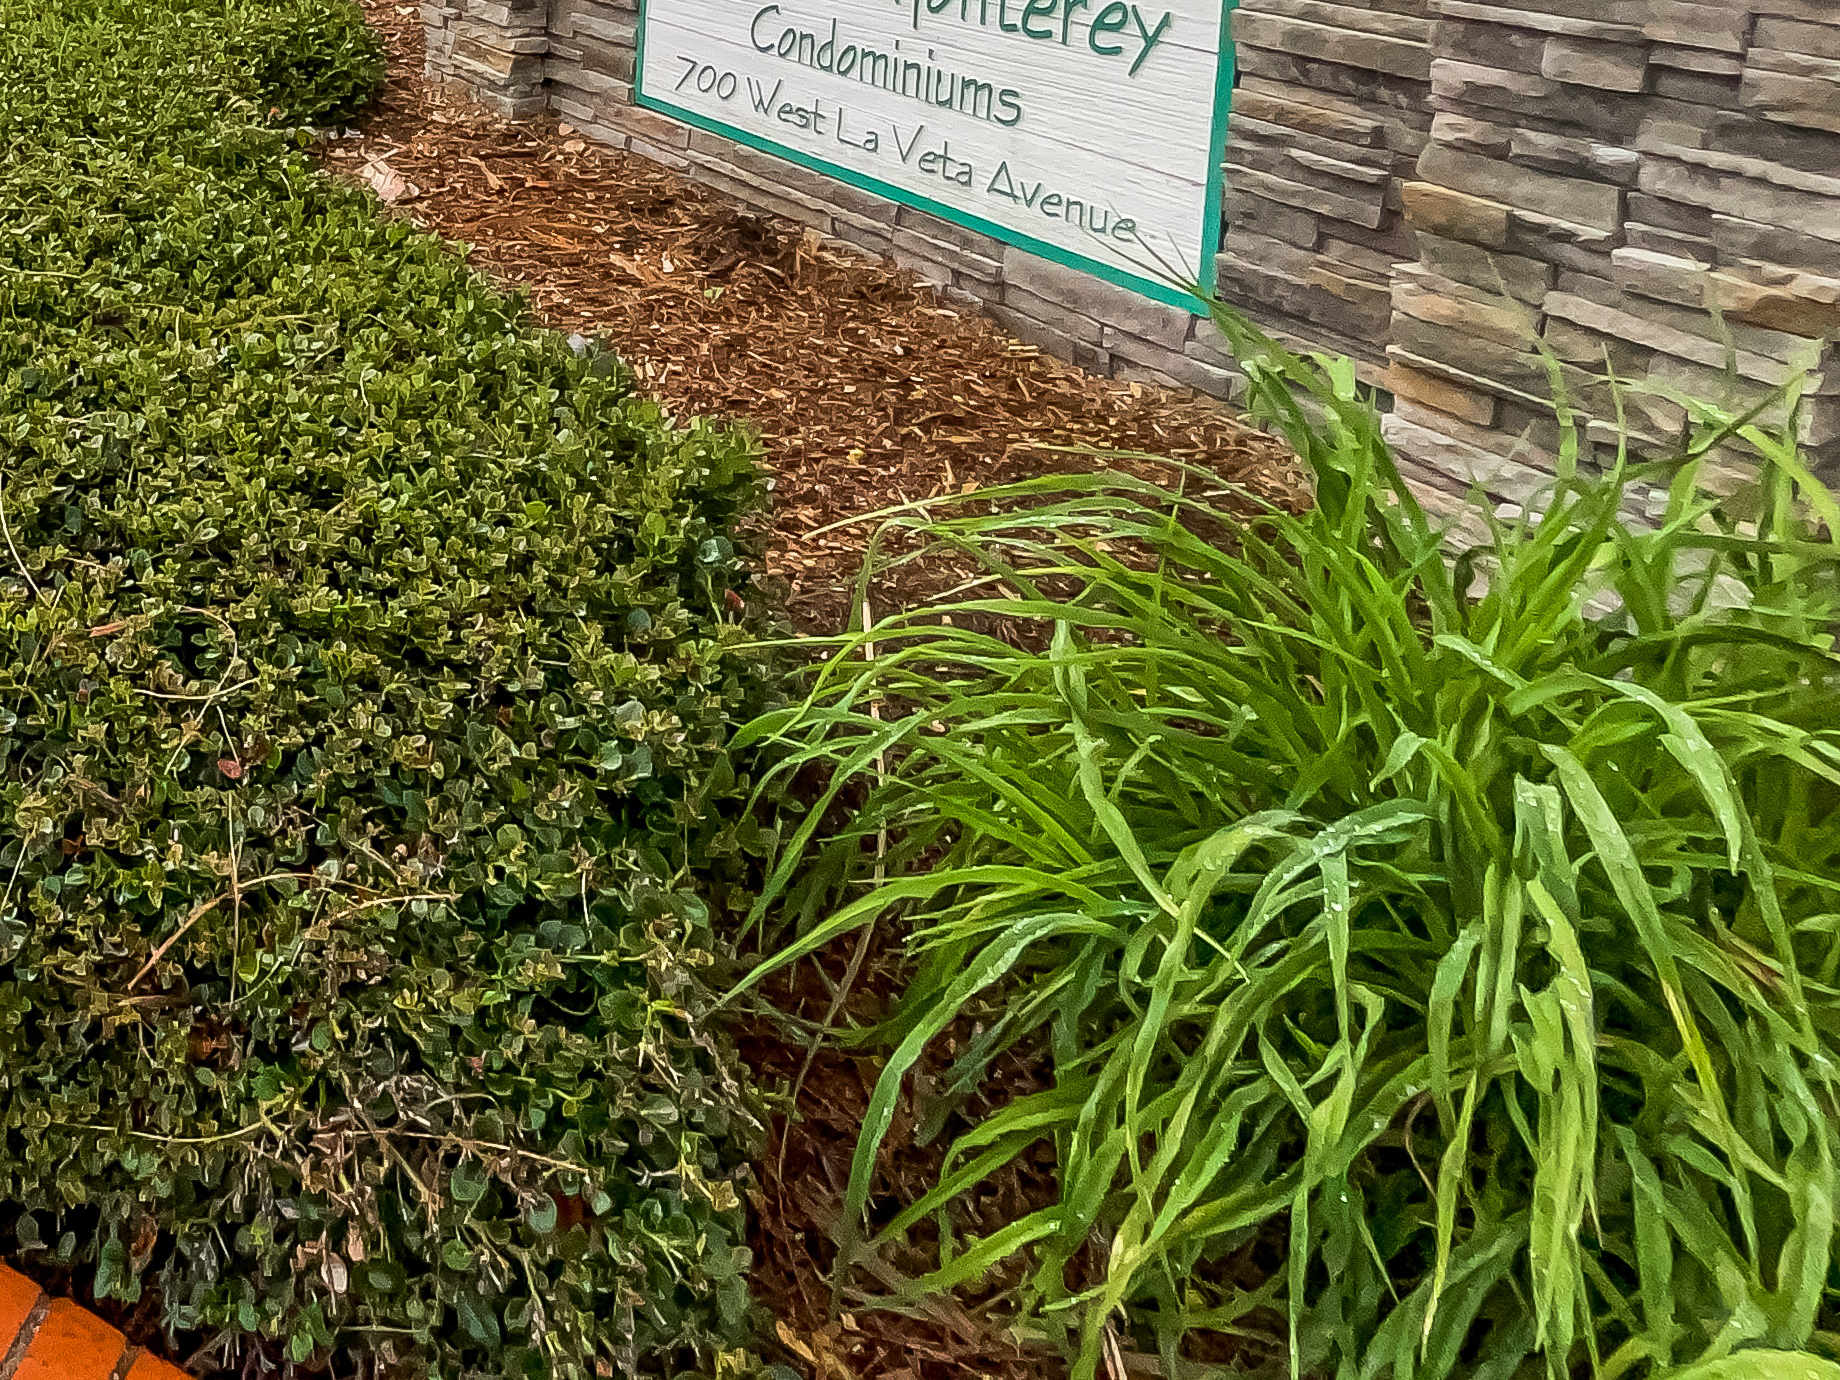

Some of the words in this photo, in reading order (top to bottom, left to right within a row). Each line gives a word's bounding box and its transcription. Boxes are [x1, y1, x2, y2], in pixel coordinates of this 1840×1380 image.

[751, 4, 1023, 127] Condominiums
[674, 55, 738, 100] 700
[746, 76, 827, 136] West
[836, 107, 880, 154] La
[892, 123, 973, 188] Veta
[987, 160, 1137, 243] Avenue
